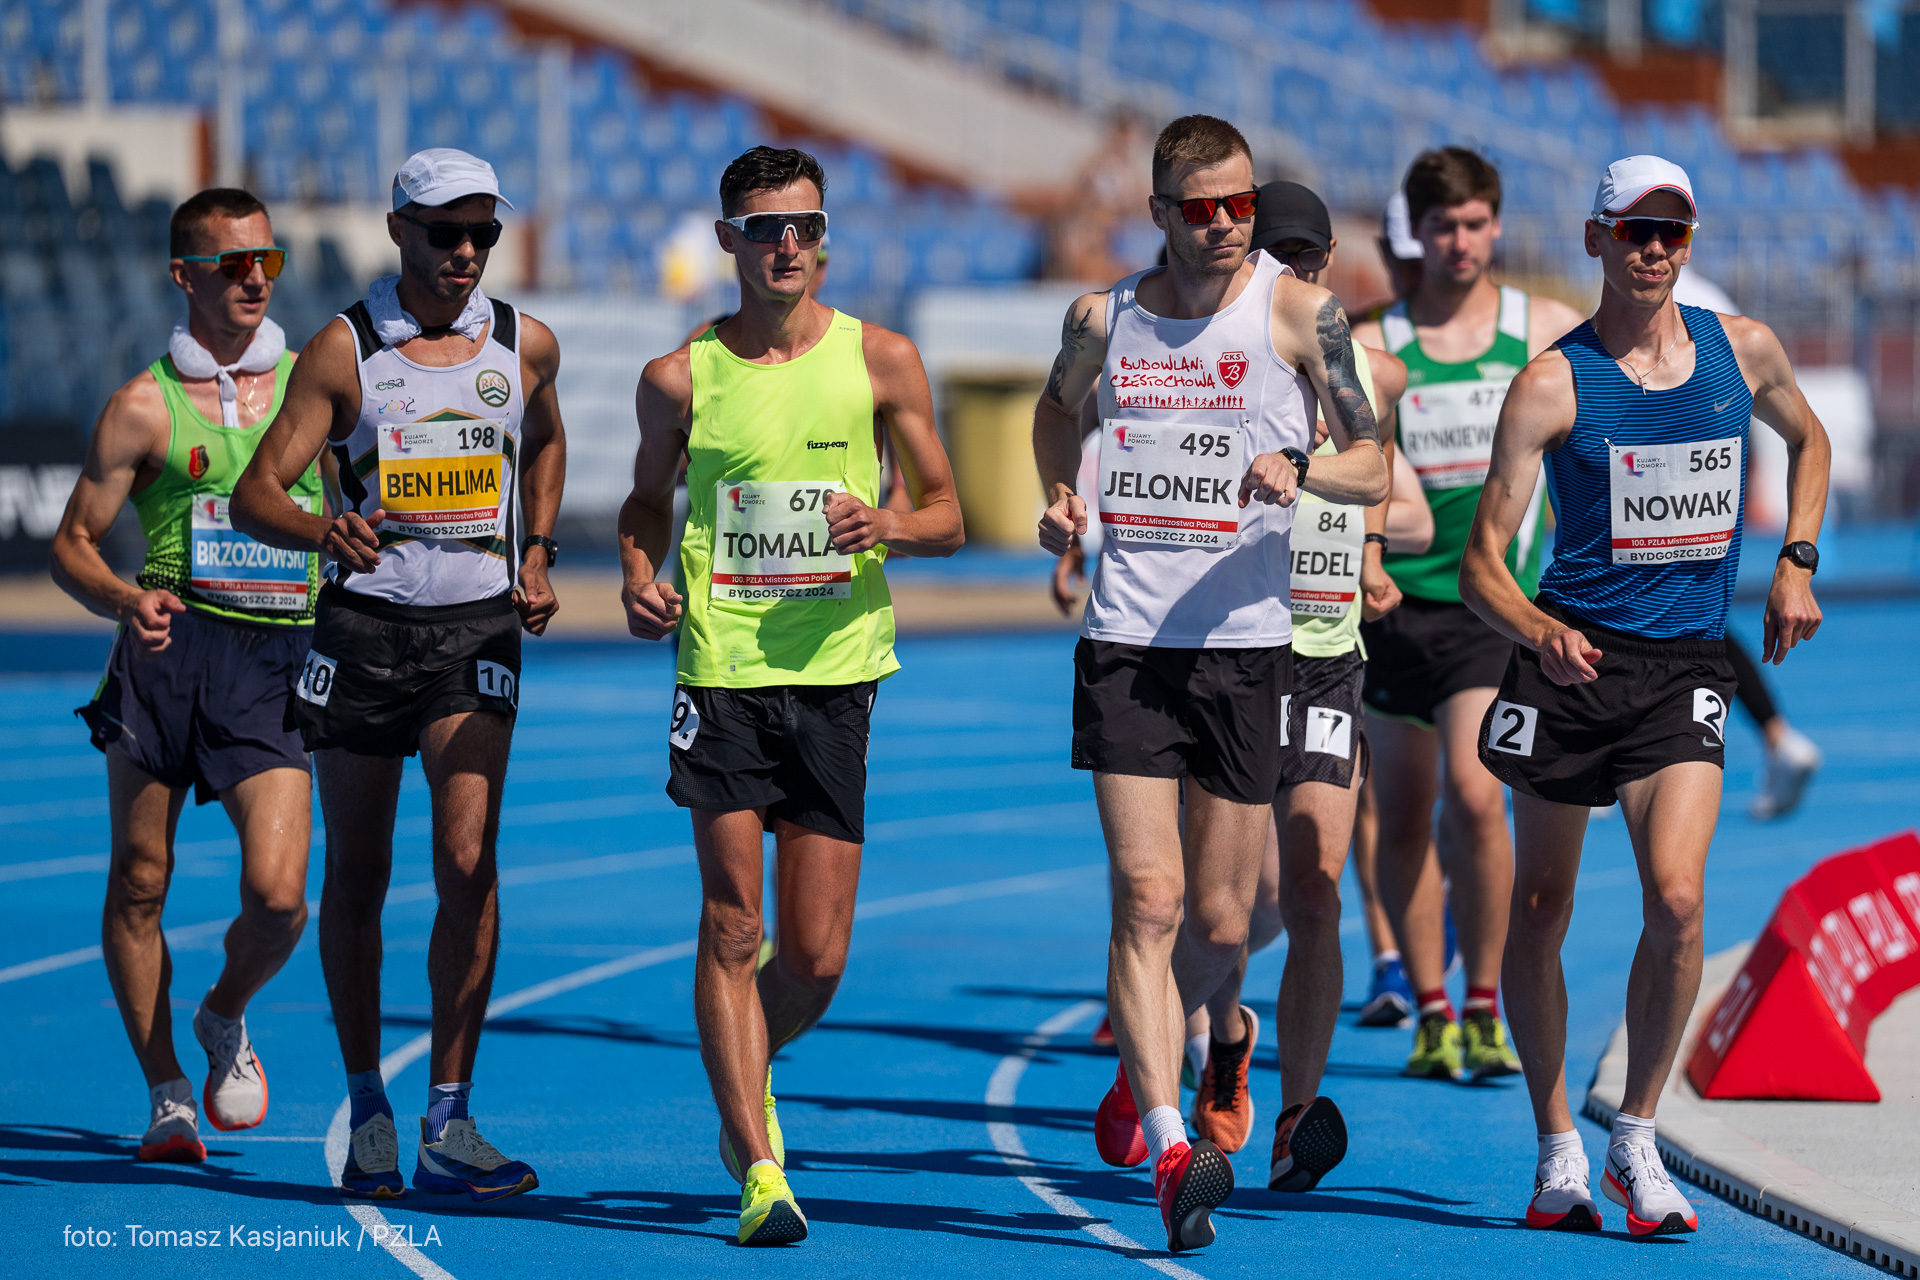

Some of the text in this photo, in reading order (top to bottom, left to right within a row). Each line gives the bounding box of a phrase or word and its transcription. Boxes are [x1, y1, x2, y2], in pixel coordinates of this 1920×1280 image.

[1223, 353, 1241, 361] CKS
[1224, 363, 1241, 381] B
[481, 375, 505, 390] RKS
[457, 426, 495, 450] 198
[1179, 432, 1231, 458] 495
[1689, 447, 1732, 473] 565
[386, 468, 497, 498] BEN HLIMA
[1104, 471, 1233, 505] JELONEK
[1624, 489, 1732, 522] NOWAK
[400, 509, 493, 522] 100. PZLA Mistrzostwa Polski
[1113, 514, 1219, 529] 100. PZLA Mistrzostwa Polski
[1317, 511, 1348, 533] 84
[398, 522, 496, 536] BYDGOSZCZ 2024
[1112, 528, 1219, 544] BYDGOSZCZ 2024
[1631, 539, 1646, 547] 100.
[1667, 535, 1709, 545] Mistrzostwa
[1710, 532, 1728, 541] Polski
[1630, 545, 1727, 561] BYDGOSZCZ 2024
[746, 576, 763, 584] PZLA
[764, 575, 810, 584] Mistrzostwa
[811, 574, 833, 582] Polski
[279, 596, 297, 606] 2024
[729, 587, 834, 598] BYDGOSZCZ 2024
[1320, 592, 1341, 600] Polski
[1313, 604, 1340, 614] 2024
[303, 658, 331, 696] 10
[479, 666, 514, 700] 10
[1703, 694, 1722, 734] 2
[1318, 711, 1343, 748] 7
[1495, 707, 1526, 751] 2
